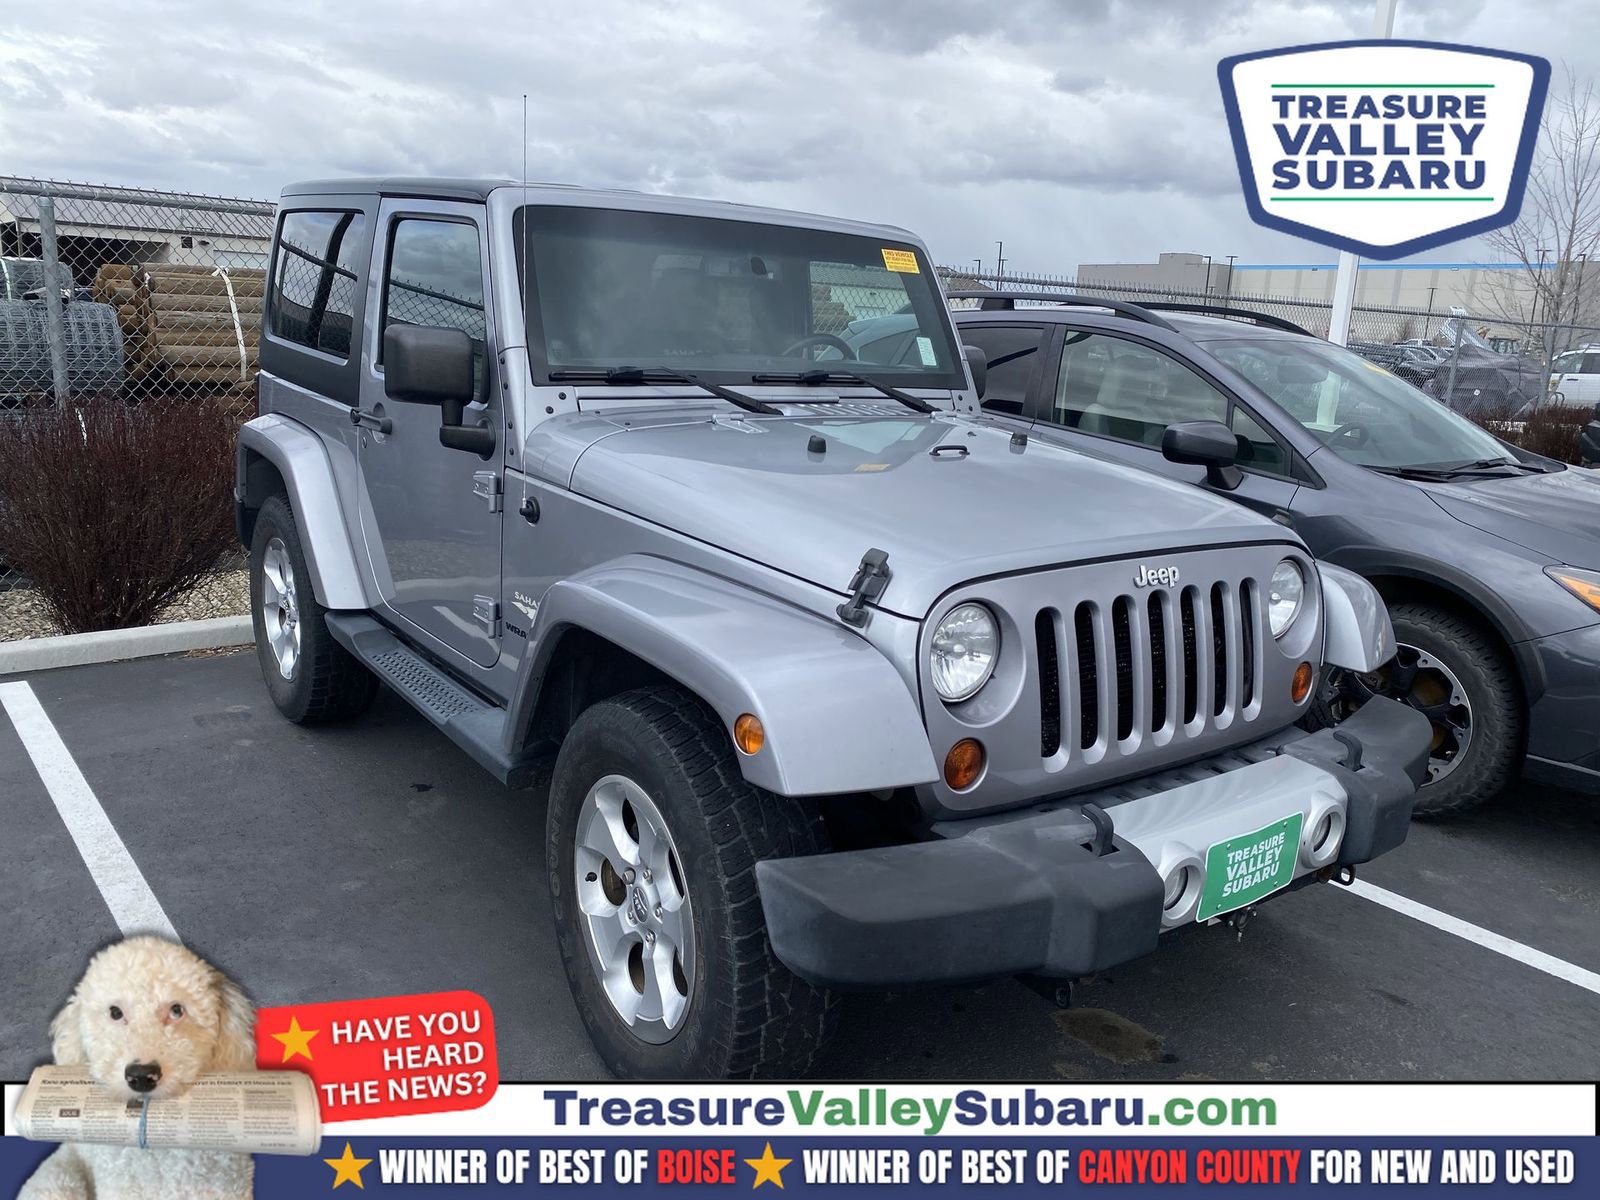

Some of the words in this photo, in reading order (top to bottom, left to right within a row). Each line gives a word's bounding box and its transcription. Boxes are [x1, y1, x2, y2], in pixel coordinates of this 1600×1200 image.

[1133, 564, 1180, 588] Jeep
[514, 591, 540, 608] SAHA
[505, 621, 528, 639] WRA
[1227, 832, 1285, 865] TREASURE
[1226, 845, 1283, 882] VALLEY
[1222, 861, 1280, 897] SUBARU
